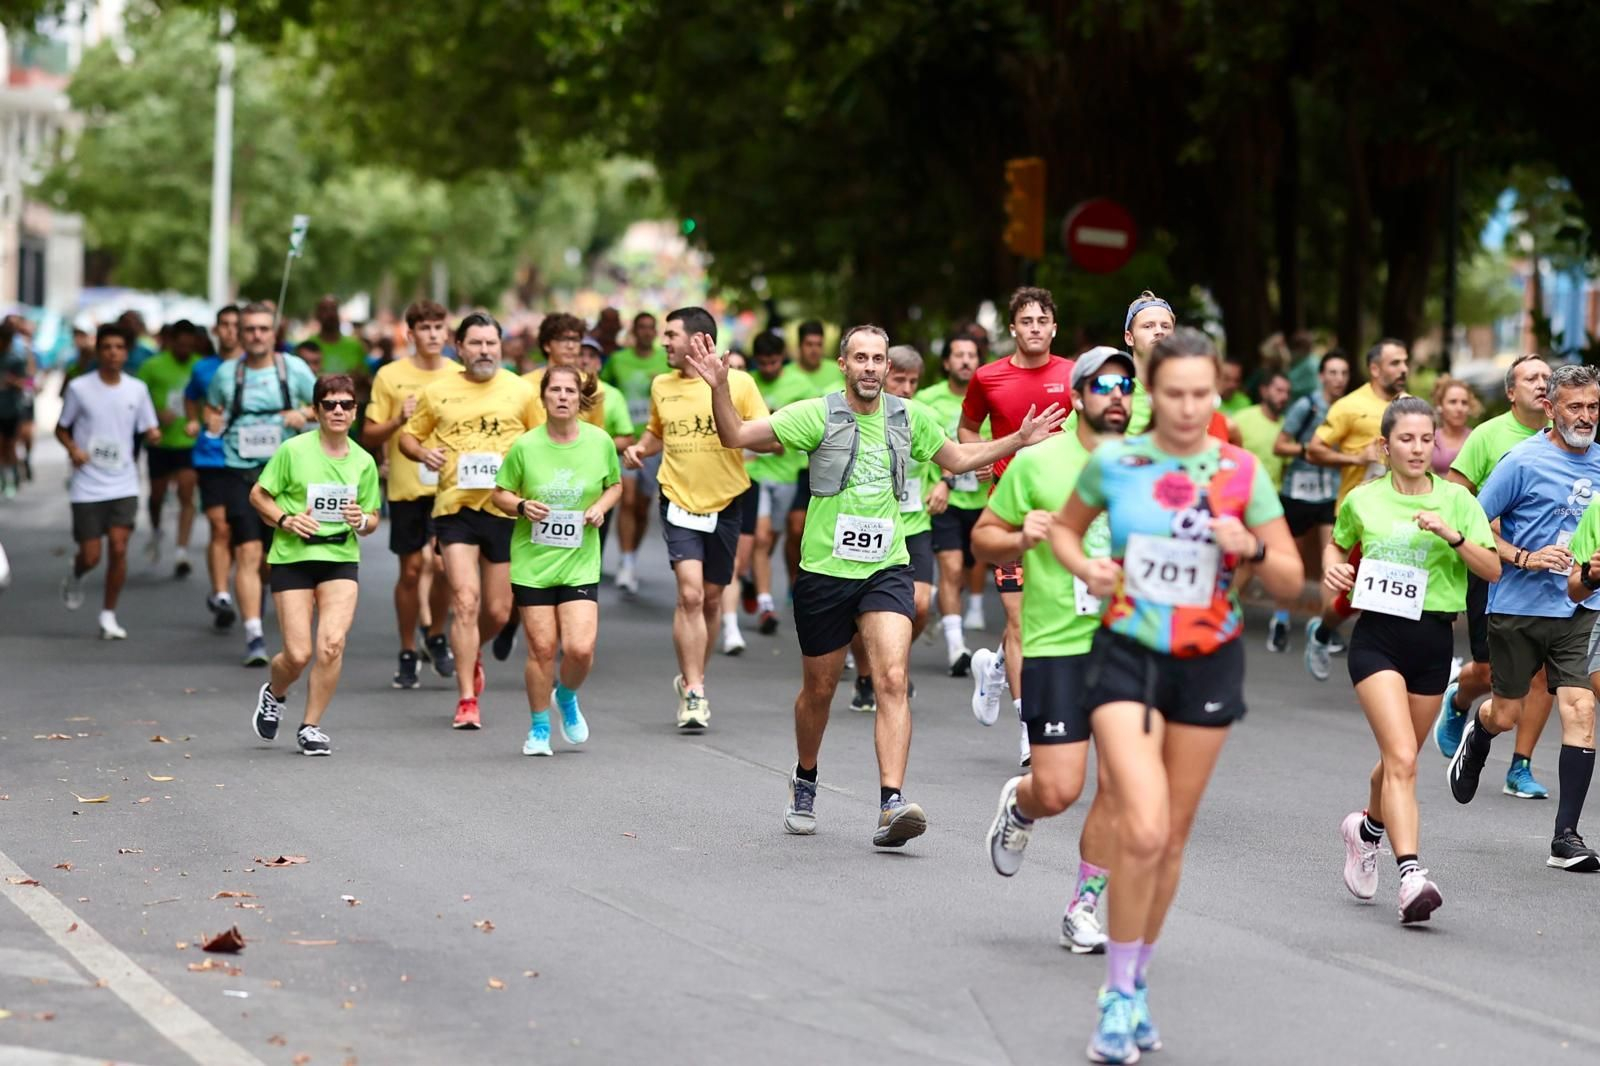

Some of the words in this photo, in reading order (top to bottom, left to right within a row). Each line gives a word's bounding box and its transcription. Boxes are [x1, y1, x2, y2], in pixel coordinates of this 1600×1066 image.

[667, 420, 690, 438] 45
[463, 465, 498, 475] 1146
[314, 497, 349, 510] 695
[539, 522, 575, 537] 700
[842, 530, 883, 548] 291
[1141, 558, 1197, 585] 701
[1364, 576, 1417, 599] 1158
